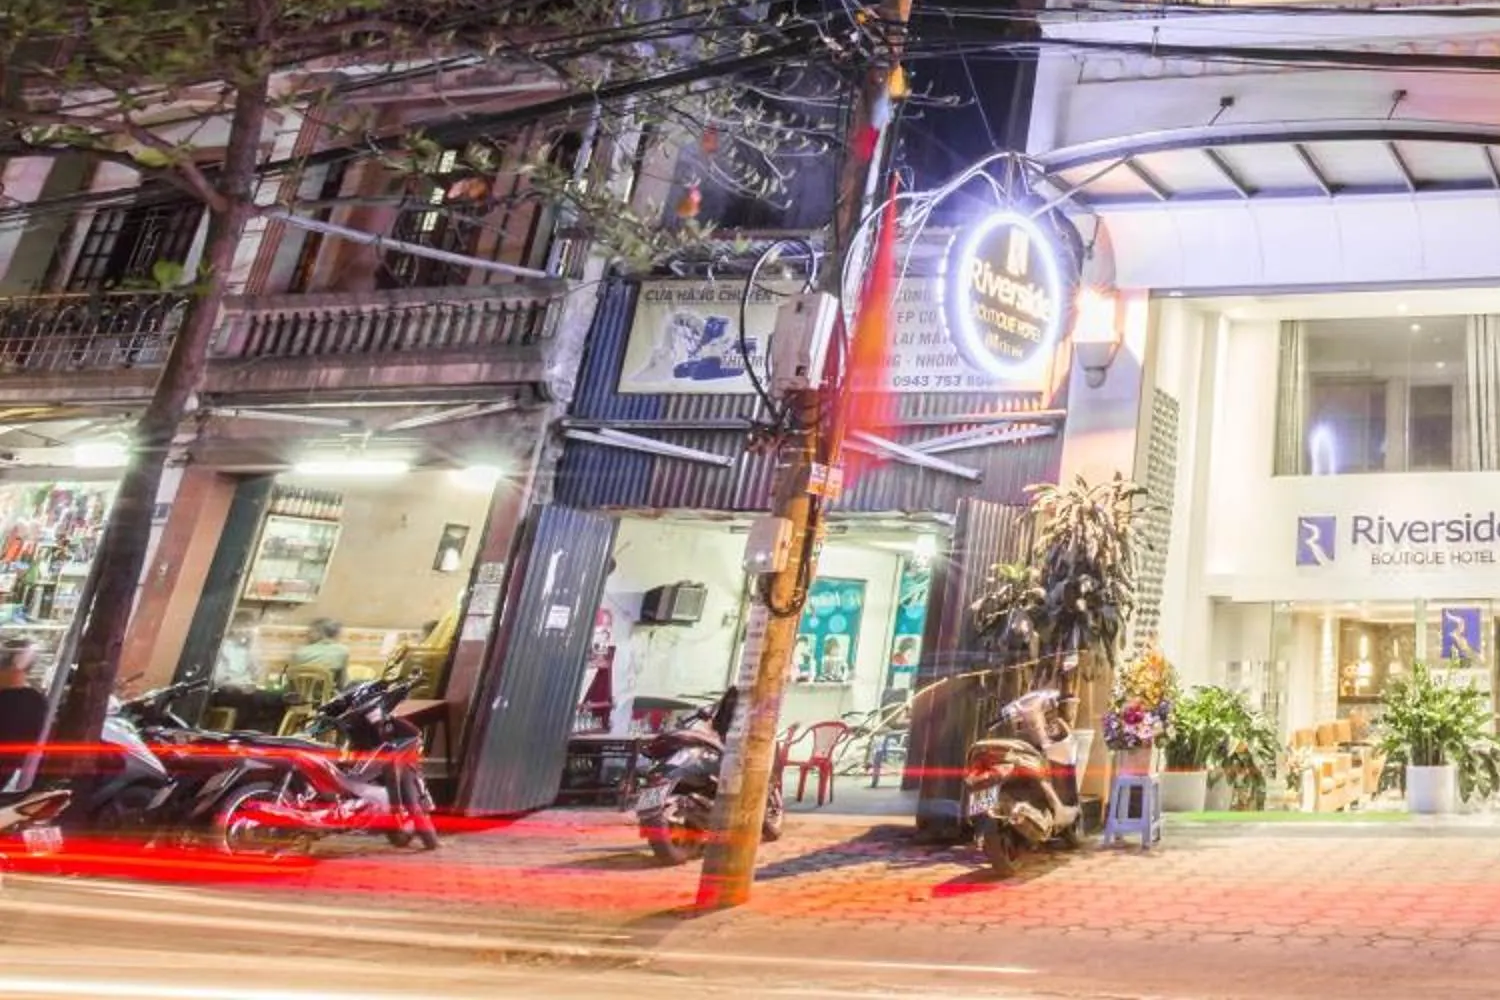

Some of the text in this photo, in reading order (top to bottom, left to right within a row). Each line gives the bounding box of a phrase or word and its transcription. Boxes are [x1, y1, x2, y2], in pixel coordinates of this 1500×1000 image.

[893, 375, 929, 387] 0943
[1371, 550, 1496, 565] BOUTIQUE HOTEL
